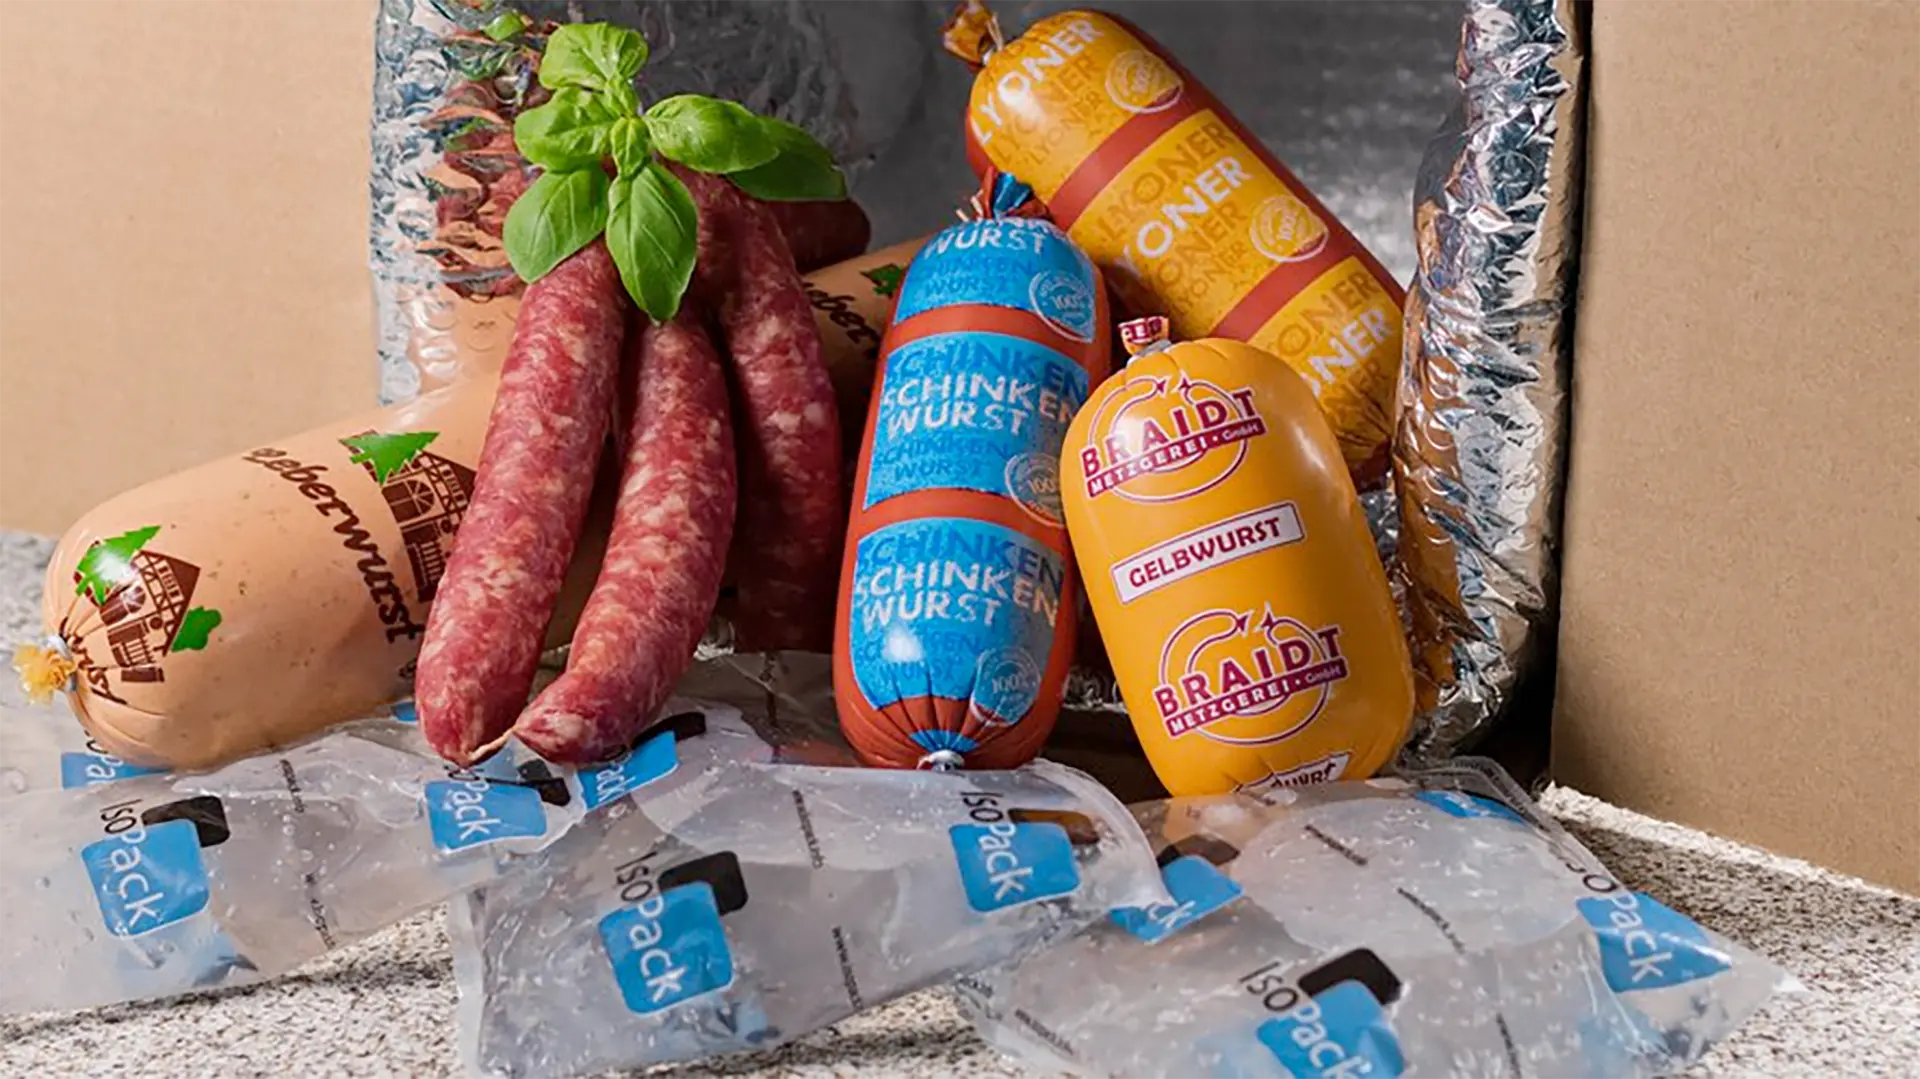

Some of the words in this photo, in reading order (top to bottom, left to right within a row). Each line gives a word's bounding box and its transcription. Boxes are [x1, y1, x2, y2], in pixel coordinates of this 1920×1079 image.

[971, 19, 1104, 146] LYONER
[923, 226, 1047, 260] WURST
[887, 399, 1029, 441] WURST
[1080, 386, 1258, 481] BRAIDT
[1089, 433, 1208, 498] METZGEREI
[1128, 516, 1281, 589] GELBWURST
[855, 559, 1058, 629] SCHINKEN
[862, 591, 1001, 635] WURST
[1154, 626, 1340, 718] BRAIDT
[1168, 679, 1292, 734] METZGEREI
[99, 798, 164, 928] IsoPack
[960, 790, 1034, 901] IsoPack
[613, 850, 689, 1004] IsoPack
